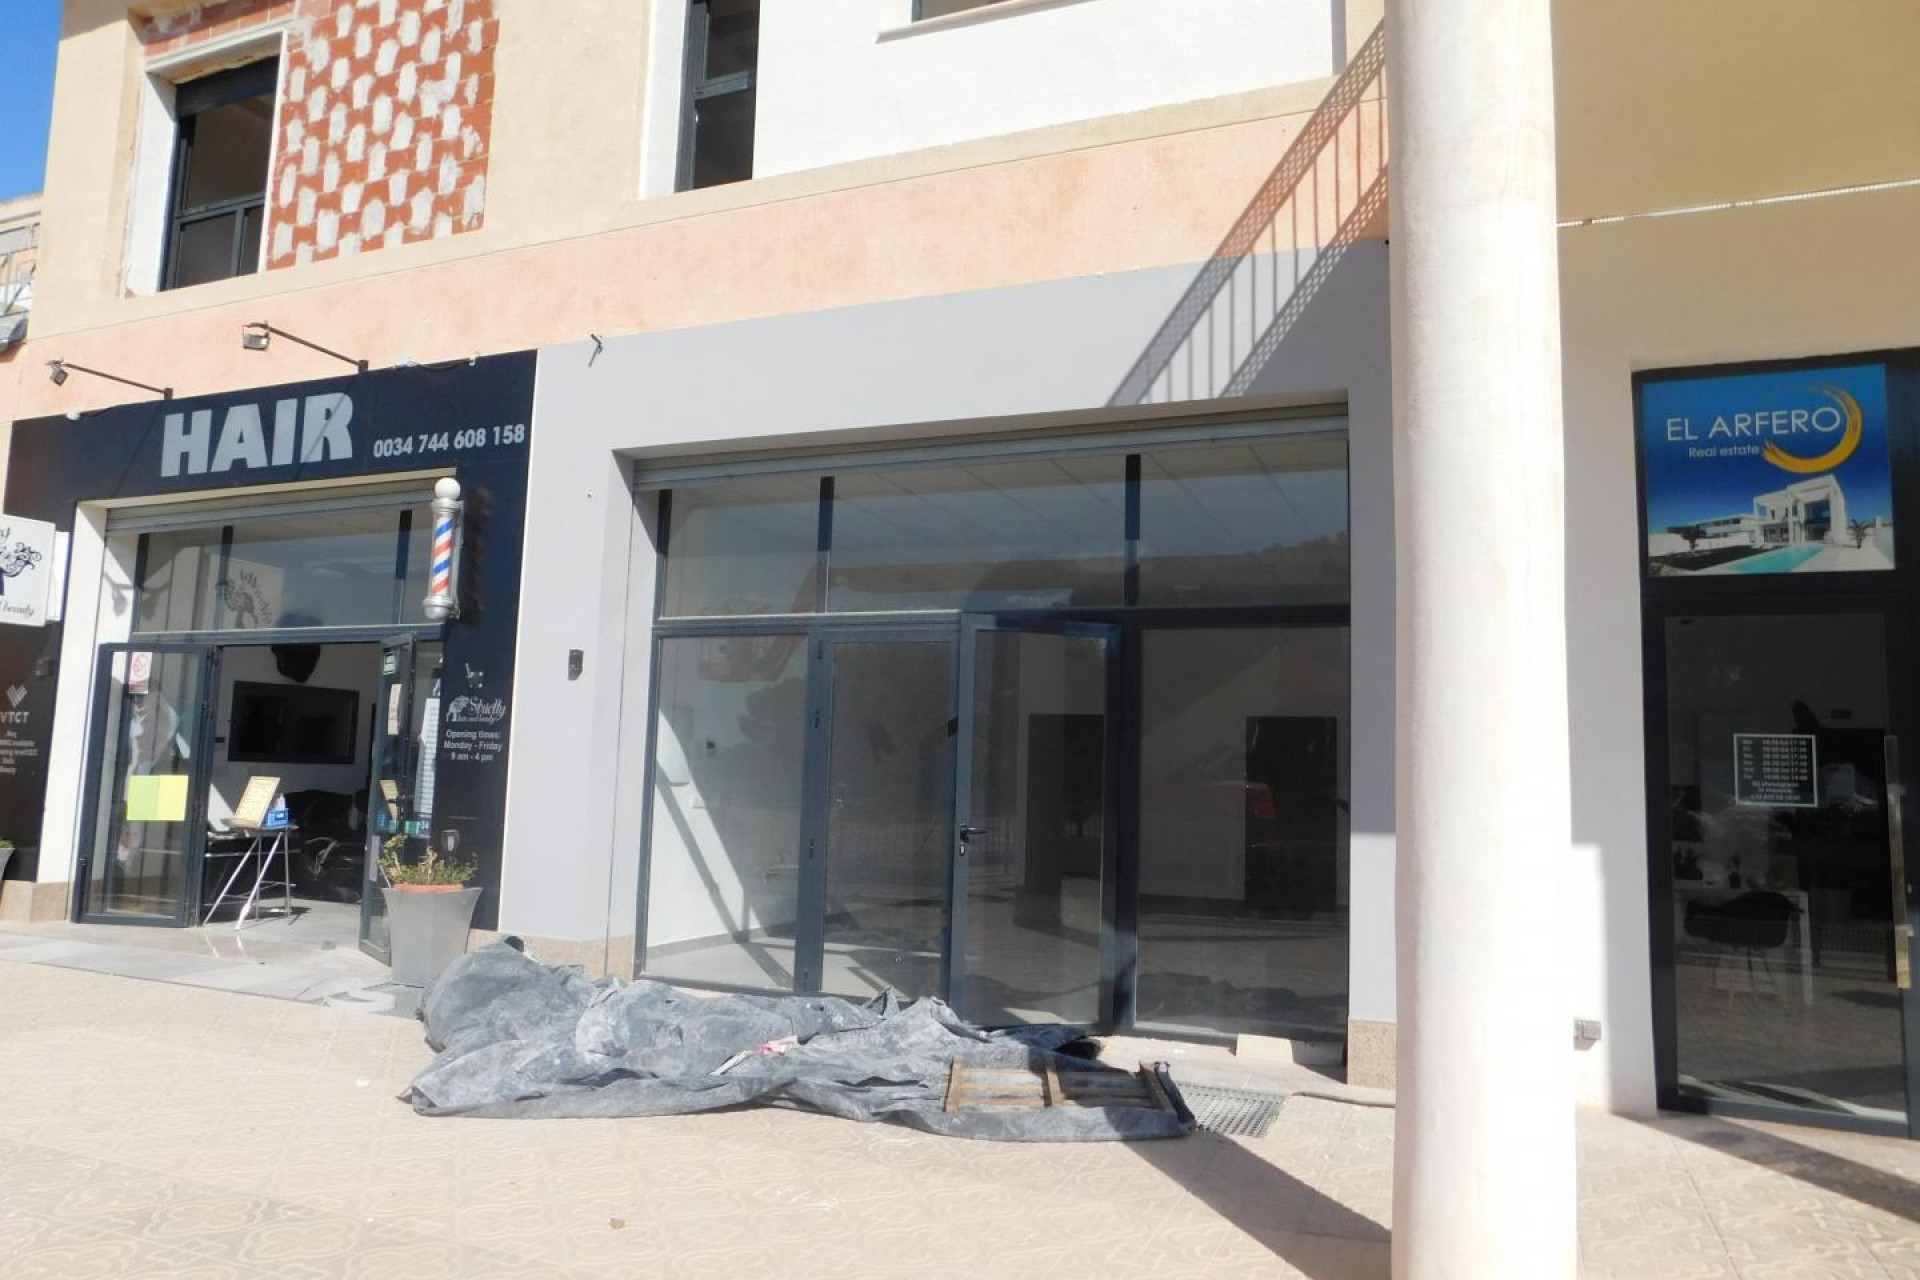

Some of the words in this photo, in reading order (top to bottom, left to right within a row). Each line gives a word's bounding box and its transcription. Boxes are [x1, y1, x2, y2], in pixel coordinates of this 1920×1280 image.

[160, 392, 354, 477] HAIR
[1666, 418, 1698, 441] EL
[1708, 407, 1841, 439] ARFERO
[373, 435, 414, 459] 0034
[417, 431, 449, 454] 744
[453, 427, 486, 449] 608
[493, 423, 525, 446] 158
[1688, 446, 1717, 458] Real
[1719, 444, 1760, 456] estate
[443, 740, 473, 752] Monday
[479, 740, 502, 752] Friday
[446, 729, 477, 741] Opening
